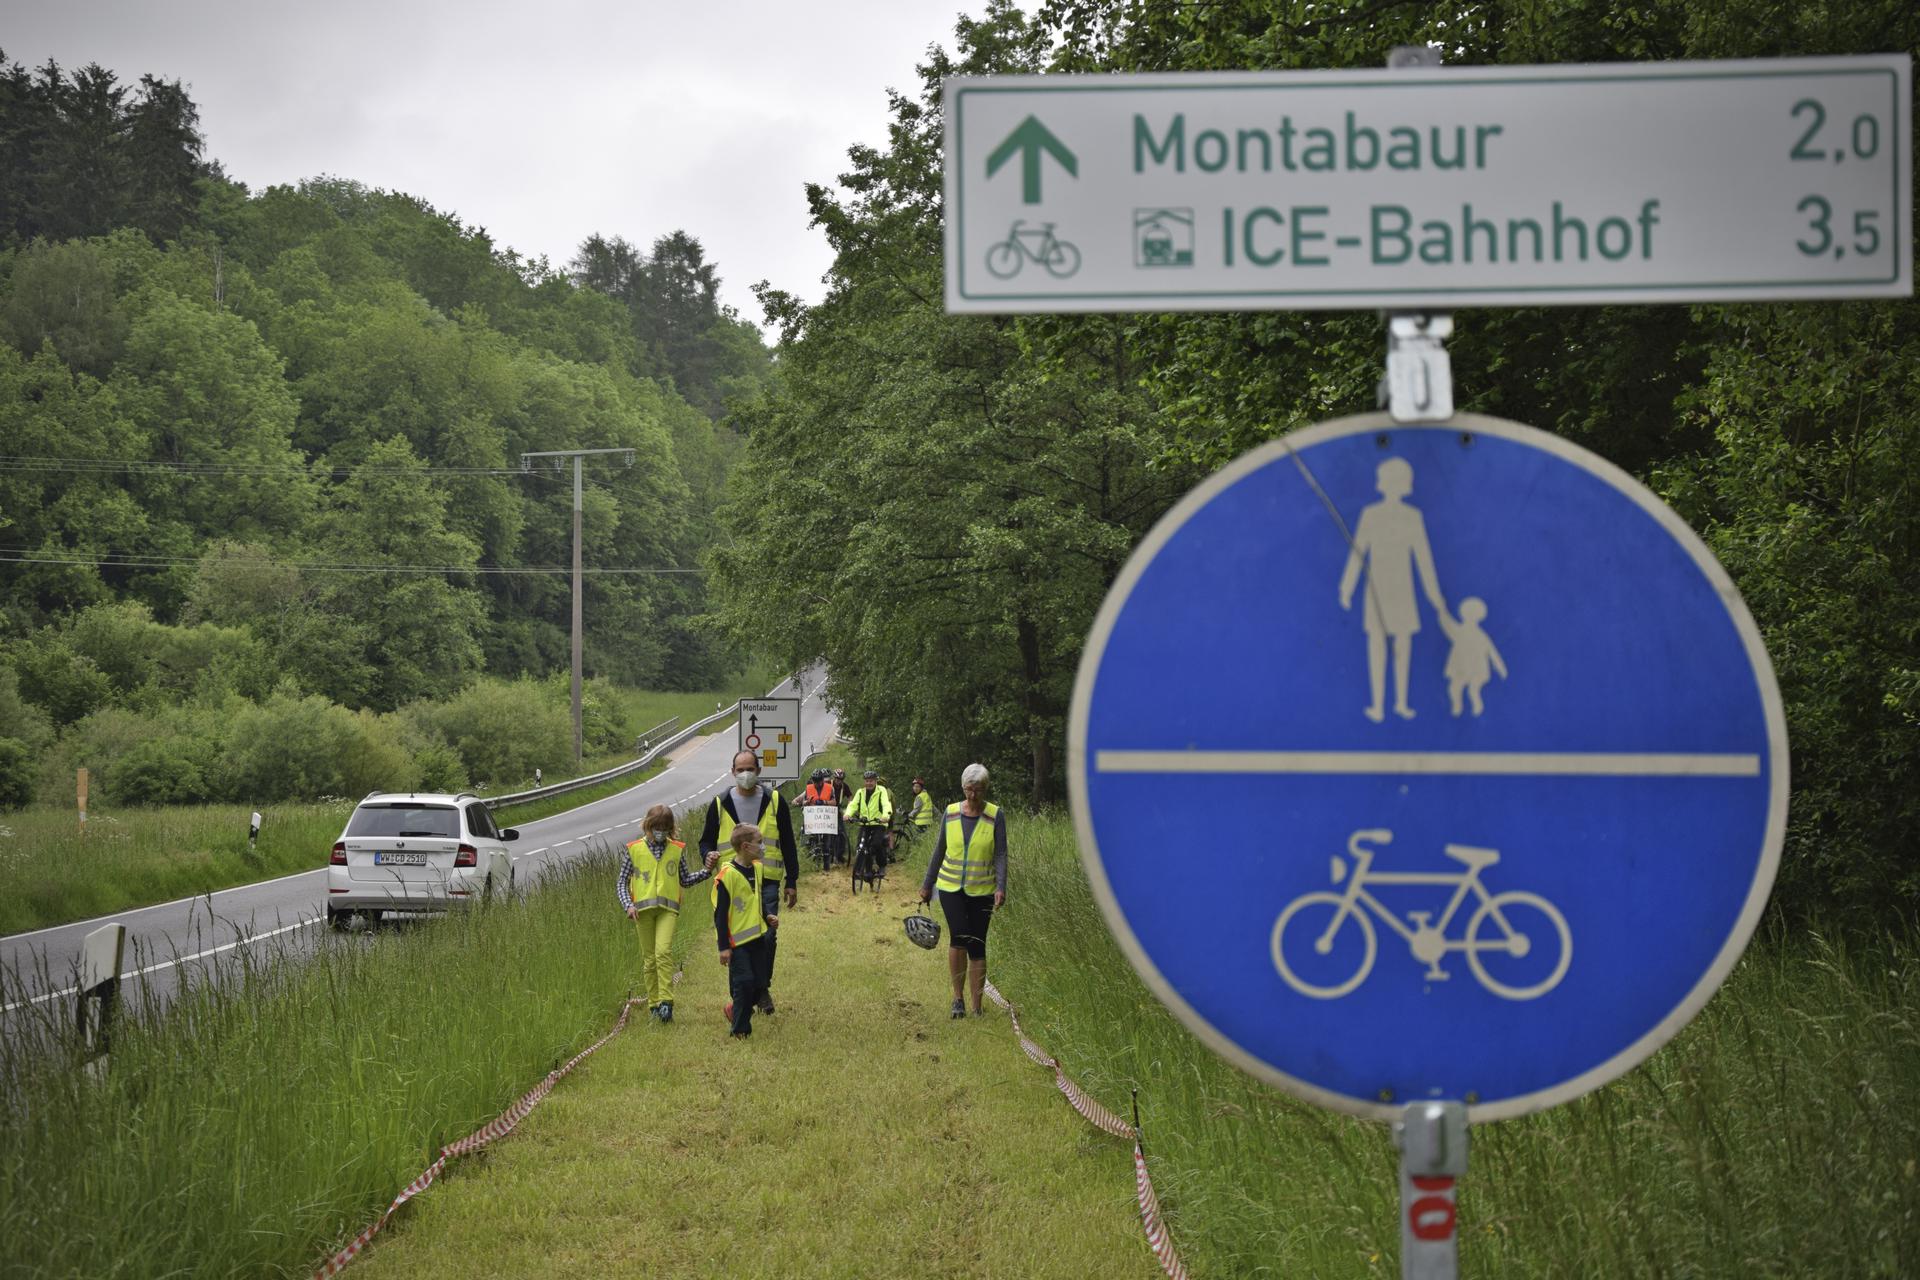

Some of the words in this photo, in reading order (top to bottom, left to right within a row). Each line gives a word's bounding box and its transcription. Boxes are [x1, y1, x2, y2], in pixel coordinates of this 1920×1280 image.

[1134, 112, 1503, 174] Montabaur
[1789, 98, 1881, 163] 2,0
[1223, 202, 1659, 267] ICE-Bahnhof
[1795, 195, 1880, 260] 3,5
[743, 703, 778, 712] Montabaur
[380, 854, 391, 863] WW
[395, 854, 405, 863] CD
[406, 854, 425, 863] 2510
